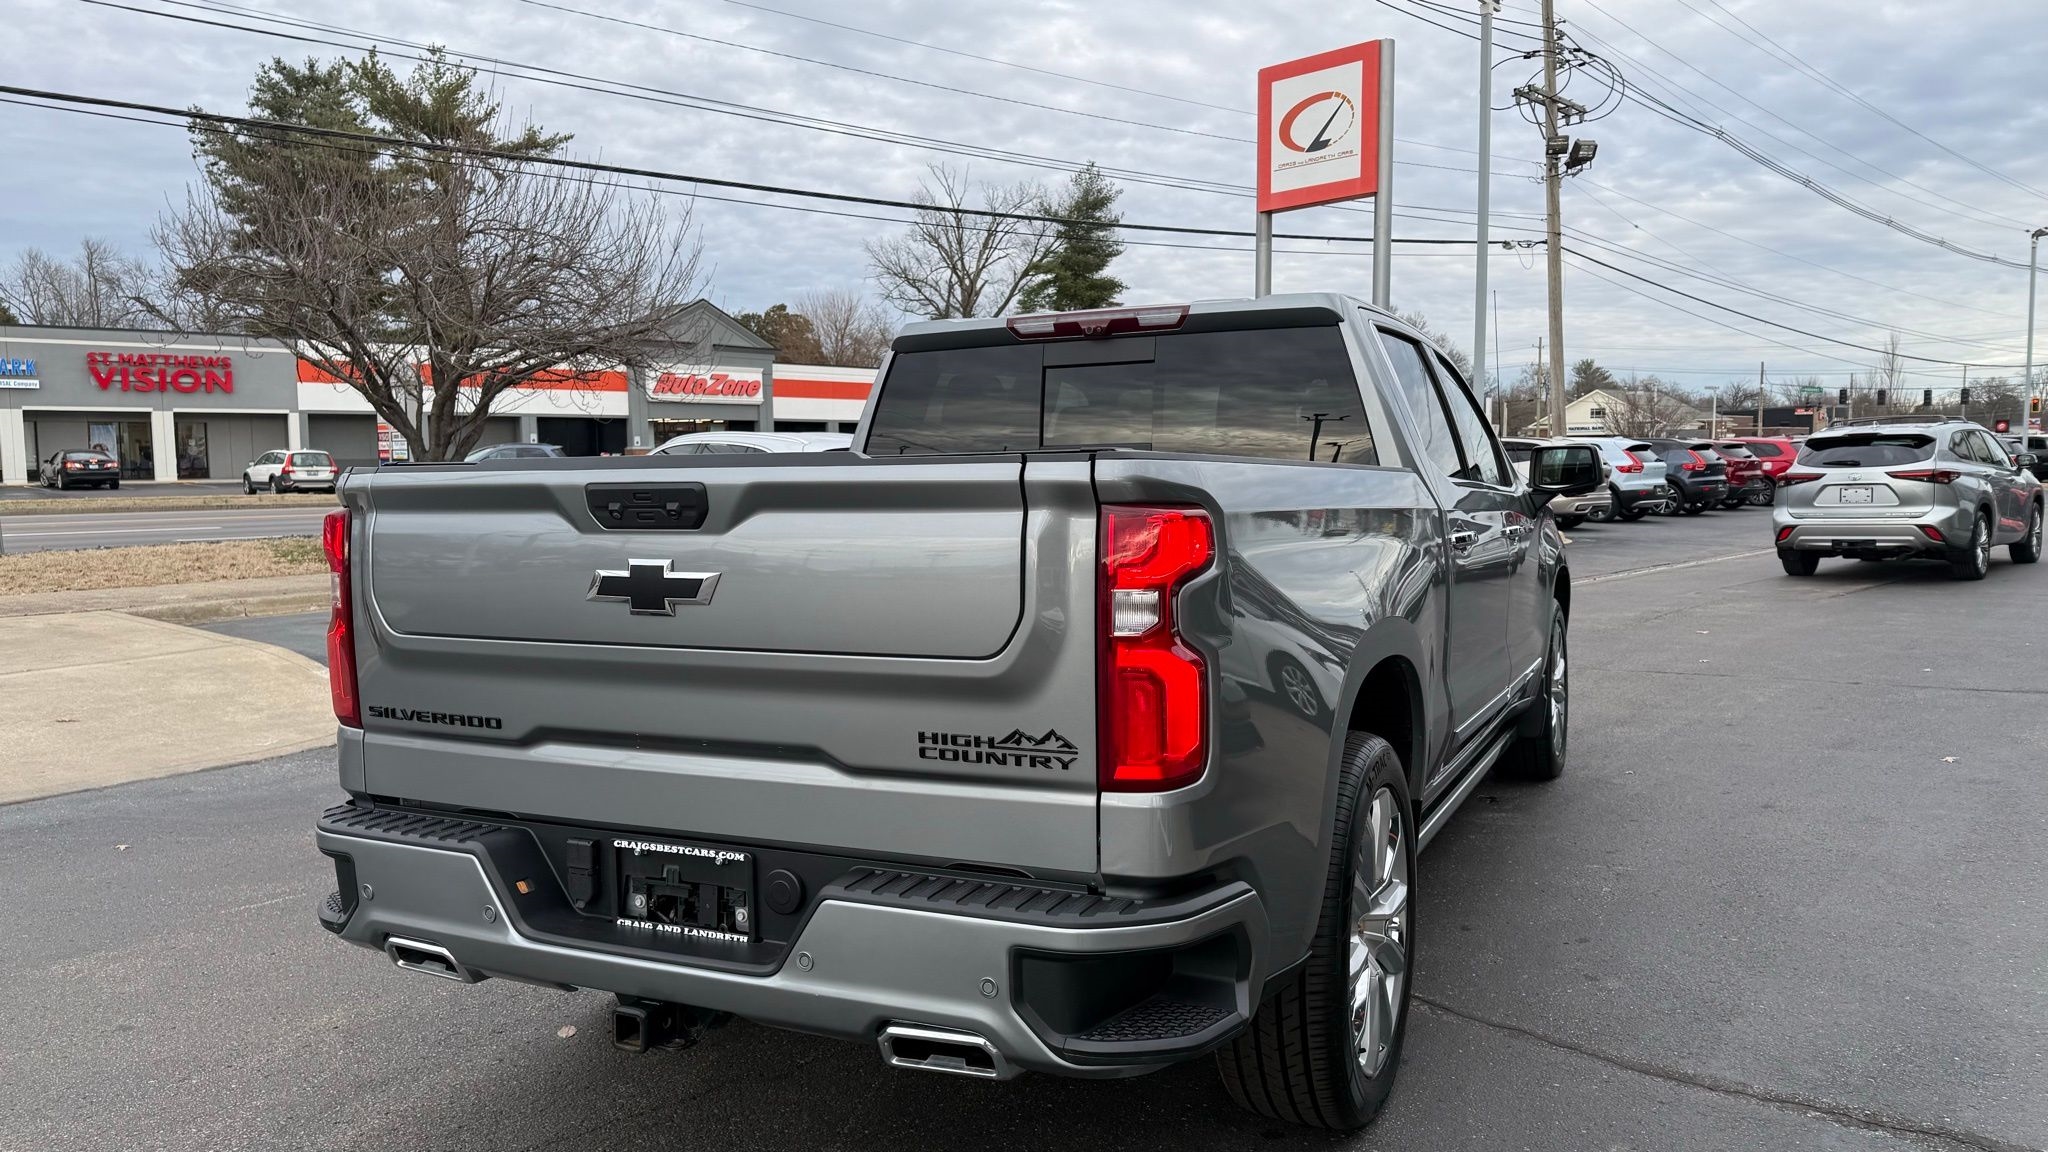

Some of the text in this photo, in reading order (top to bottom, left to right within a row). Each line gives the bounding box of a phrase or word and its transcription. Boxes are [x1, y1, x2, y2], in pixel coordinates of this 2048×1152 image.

[0, 358, 37, 376] ARK
[118, 353, 232, 369] MATTHEWS
[88, 366, 234, 394] VISION
[653, 372, 761, 397] AutoZone
[368, 705, 503, 730] SILVERADO
[917, 730, 996, 749] HIGH
[918, 746, 1078, 771] COUNTRY
[613, 839, 745, 862] CRAIGSBESTCARS.COM
[616, 918, 749, 943] CRAIG AND LANDRETH
